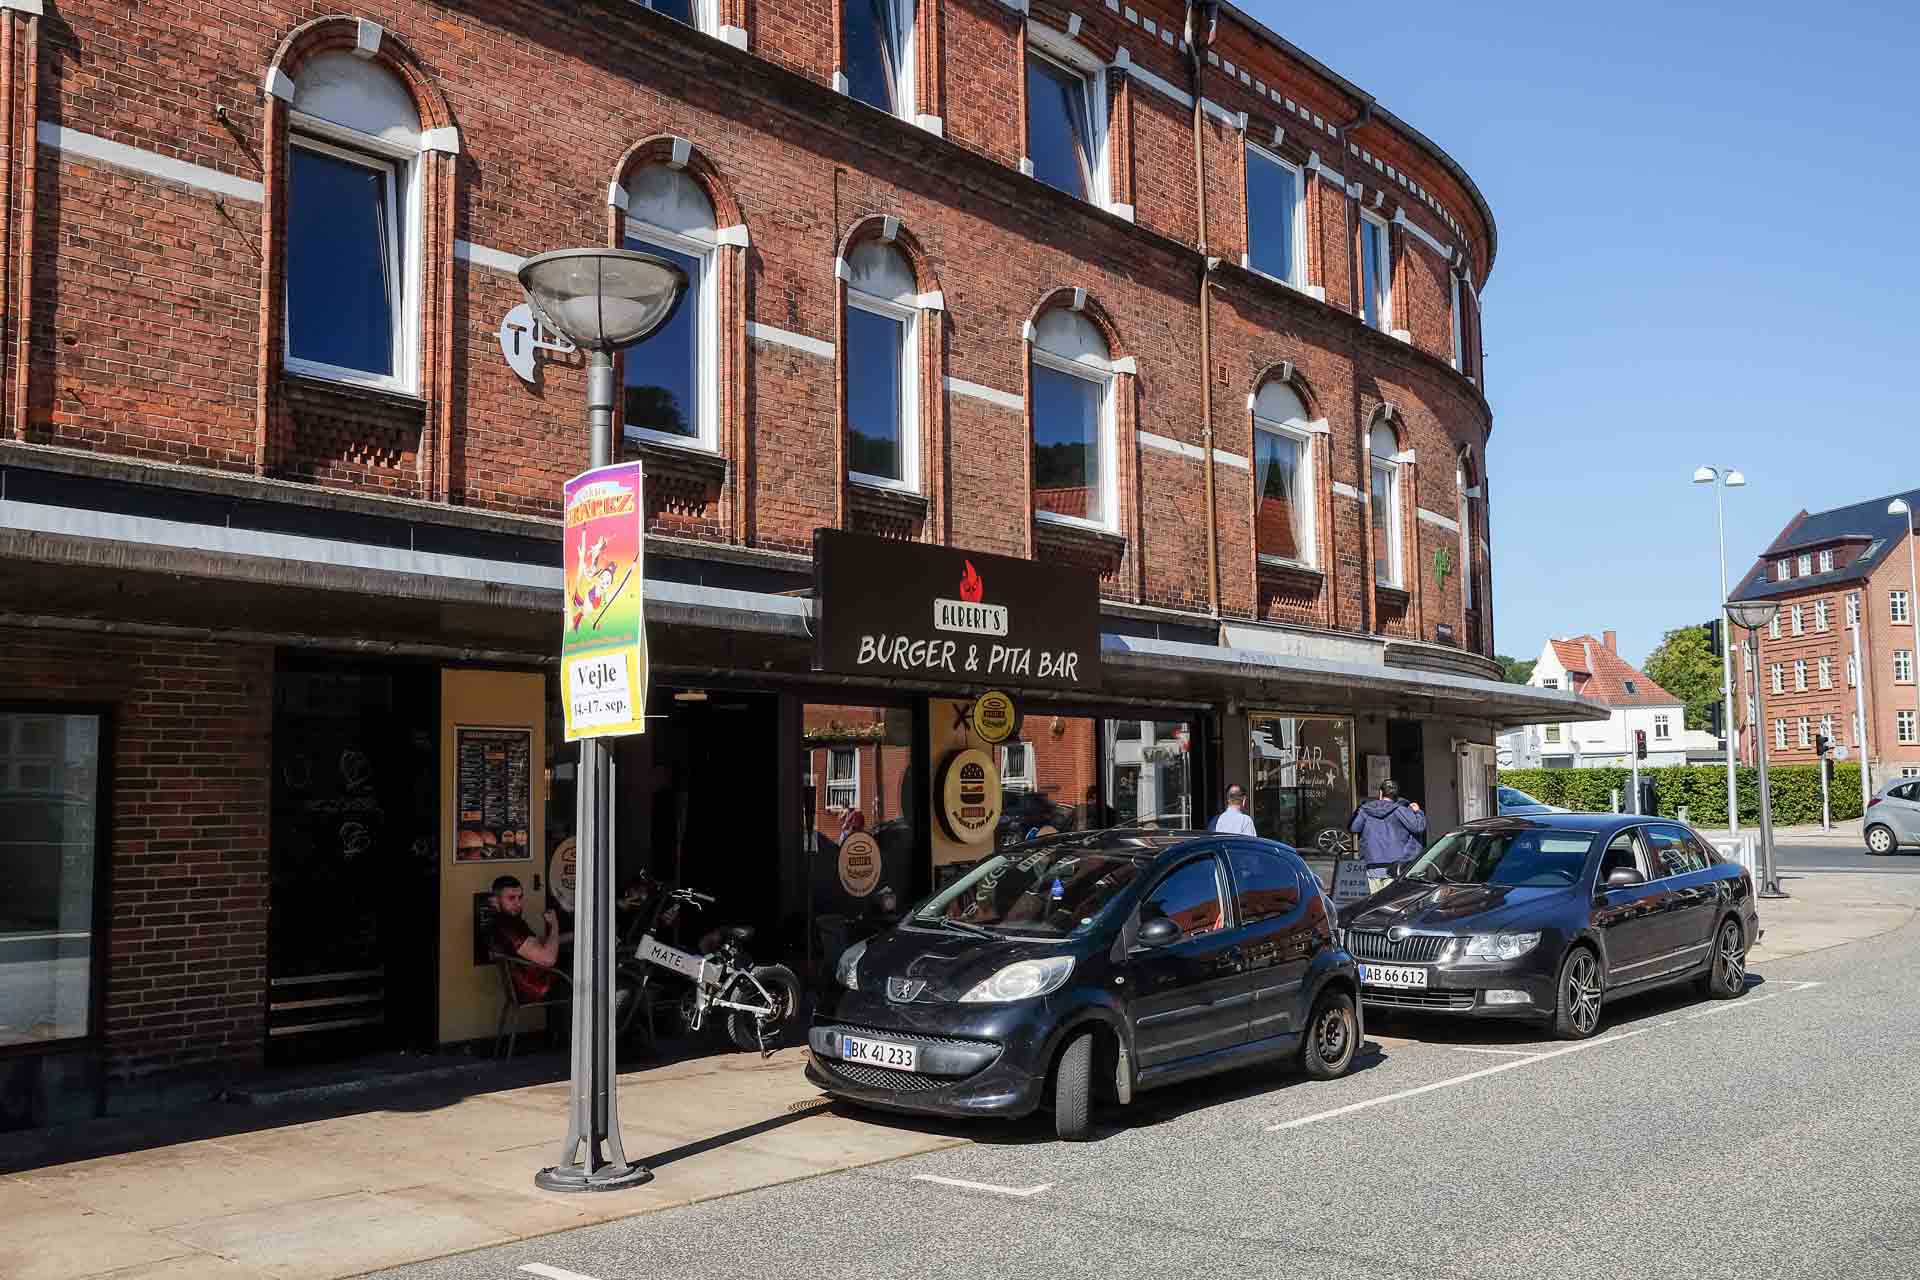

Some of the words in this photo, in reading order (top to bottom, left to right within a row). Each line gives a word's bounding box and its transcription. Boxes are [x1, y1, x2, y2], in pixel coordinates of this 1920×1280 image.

[942, 604, 1001, 630] ALBERT'S
[857, 633, 956, 673] BURGER
[964, 644, 979, 671] &
[987, 645, 1031, 675] PITA
[1037, 651, 1078, 681] BAR
[577, 663, 617, 689] Vejle
[605, 699, 627, 715] sep.
[1366, 967, 1382, 981] AB
[1384, 969, 1399, 982] 66
[1401, 970, 1424, 984] 612
[852, 1041, 867, 1059] BK
[872, 1045, 884, 1063] 41
[888, 1047, 912, 1066] 233
